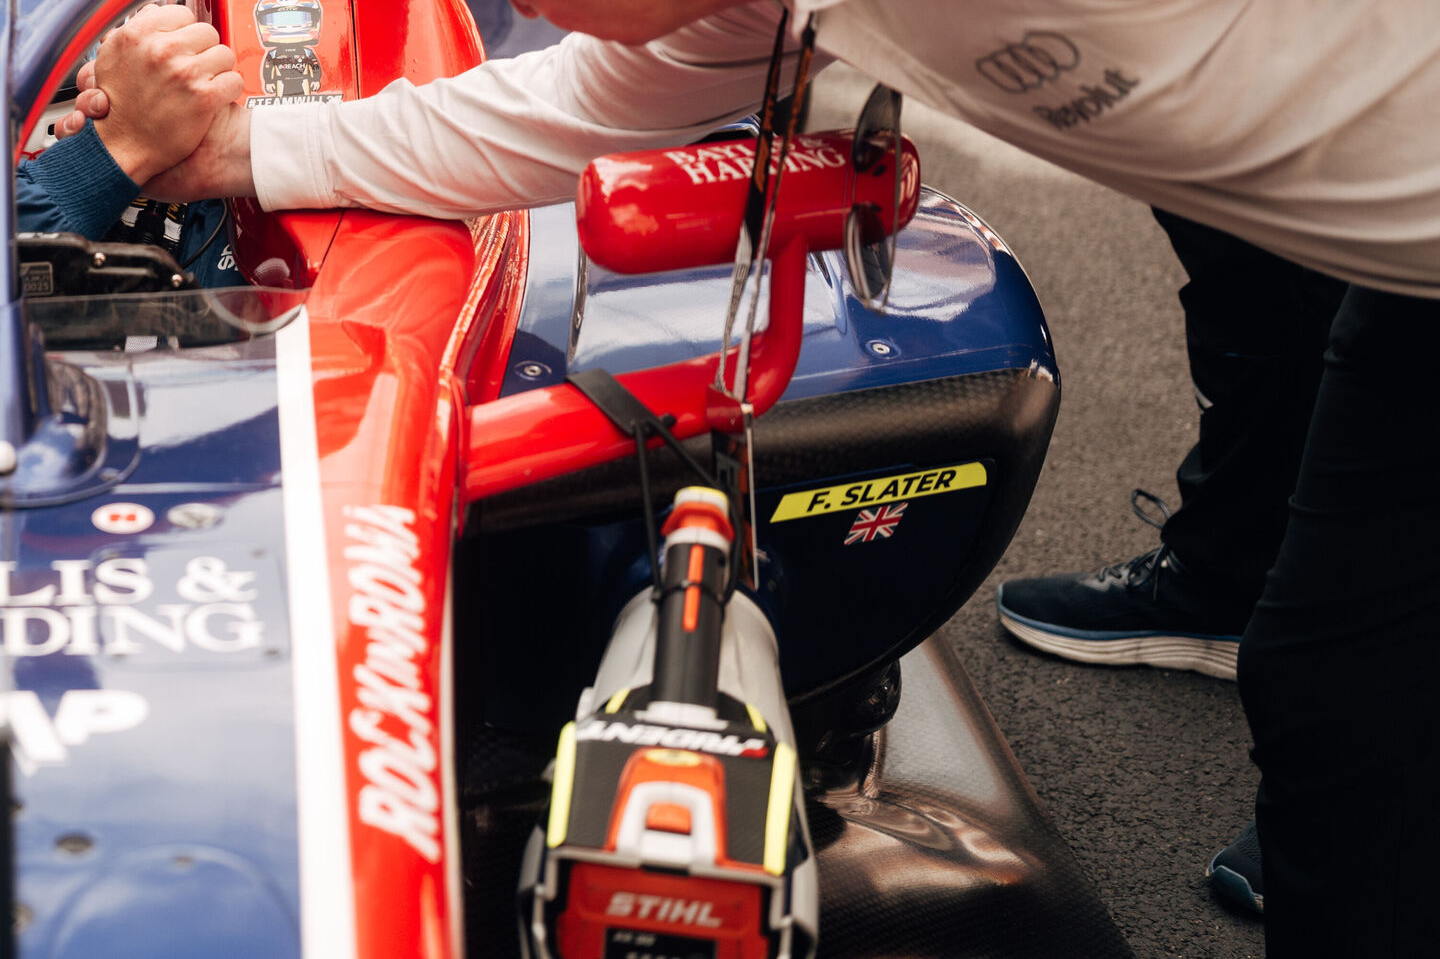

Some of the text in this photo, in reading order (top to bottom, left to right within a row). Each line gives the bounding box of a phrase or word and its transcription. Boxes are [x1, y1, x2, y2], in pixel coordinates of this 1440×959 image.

[806, 469, 957, 513] F. SLATER
[176, 556, 258, 604] &
[607, 891, 722, 929] STIHL
